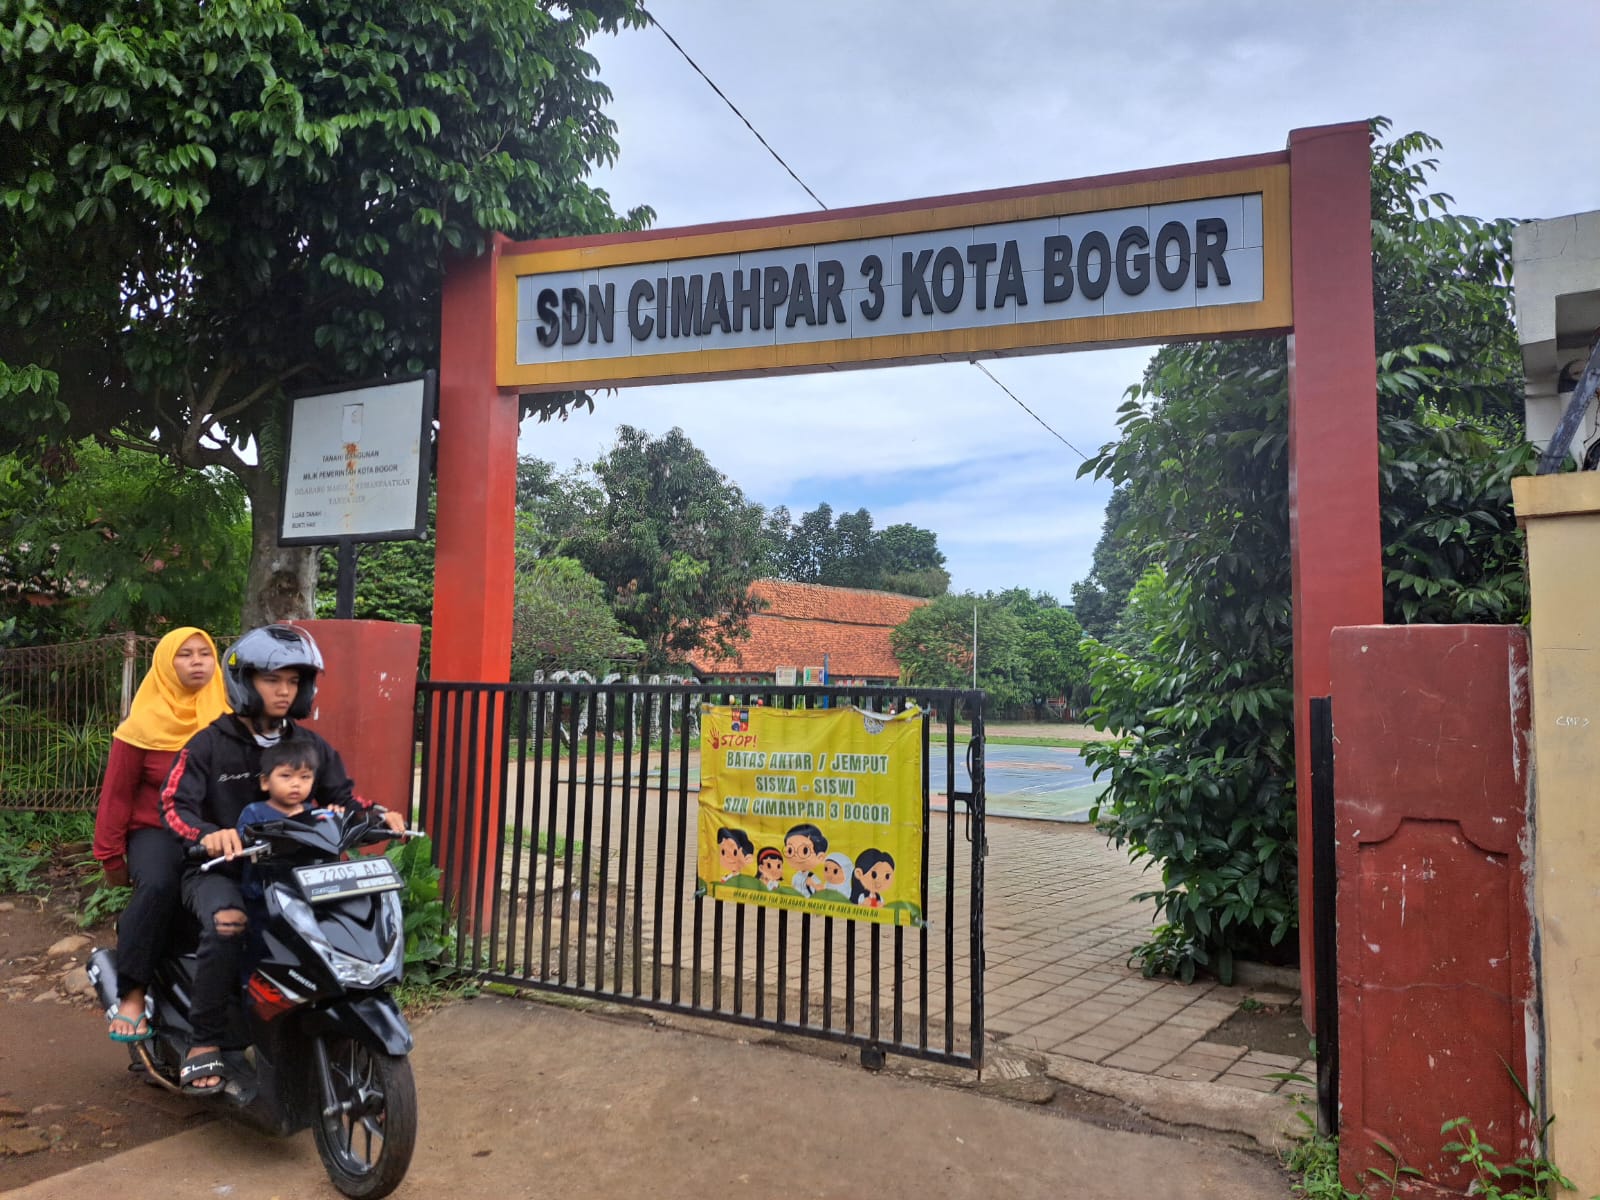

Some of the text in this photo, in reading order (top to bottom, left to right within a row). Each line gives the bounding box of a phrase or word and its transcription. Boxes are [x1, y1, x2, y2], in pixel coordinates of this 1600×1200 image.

[536, 217, 1232, 347] SDN CIMAHPAR 3 KOTA BOGOR
[358, 466, 374, 474] KOTA
[375, 464, 398, 473] BOGOR
[721, 734, 758, 748] STOP!
[726, 751, 888, 773] BATAS ANTAR / JEMPUT
[755, 776, 797, 794] SISWA
[814, 778, 856, 797] SISWI
[723, 797, 891, 823] SDN CIMAHPAR 3 BOGOR
